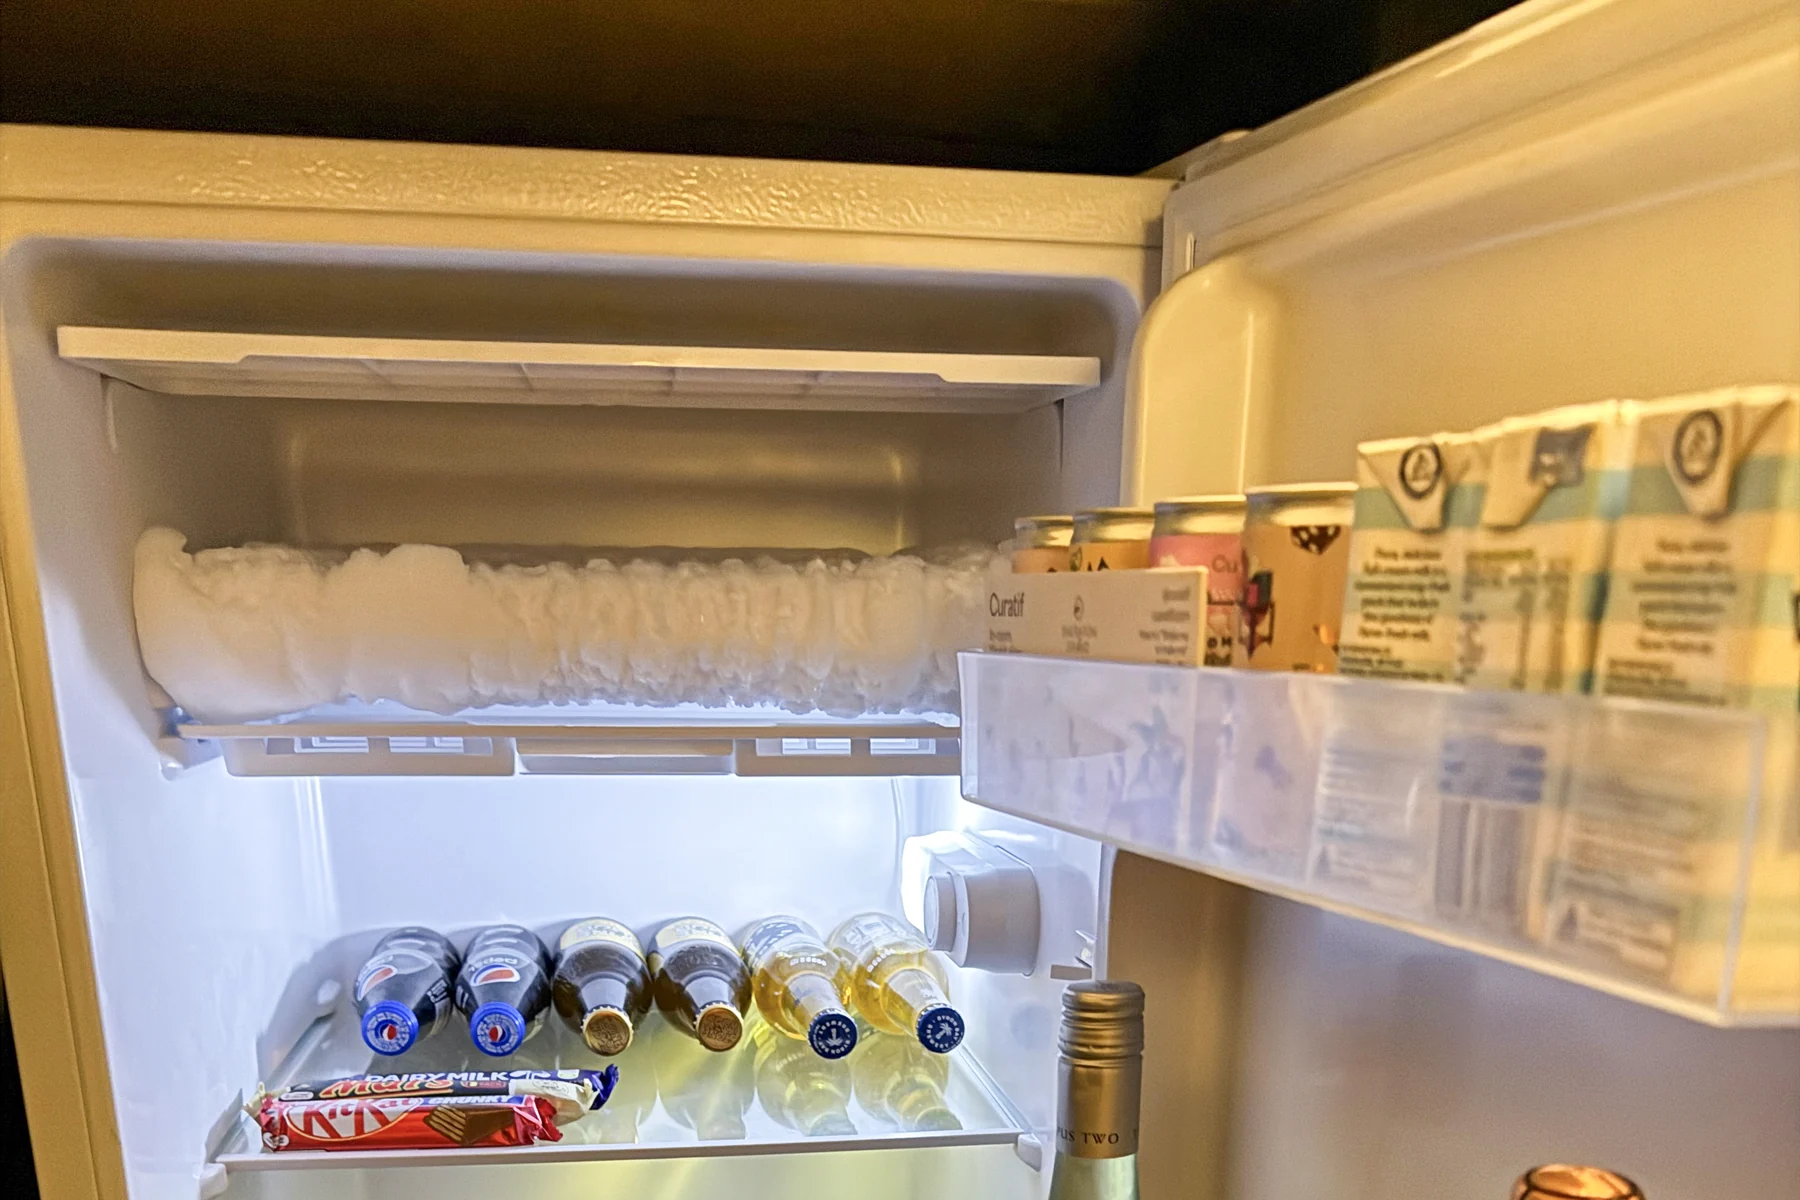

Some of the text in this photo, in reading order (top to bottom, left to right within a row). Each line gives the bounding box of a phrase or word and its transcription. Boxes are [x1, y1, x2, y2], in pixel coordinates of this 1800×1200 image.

[989, 592, 1024, 617] Curatif
[365, 1071, 509, 1082] DAIRY MILK
[319, 1079, 454, 1099] Mars
[428, 1095, 511, 1104] CHUNKY
[1081, 1131, 1120, 1145] TWO
